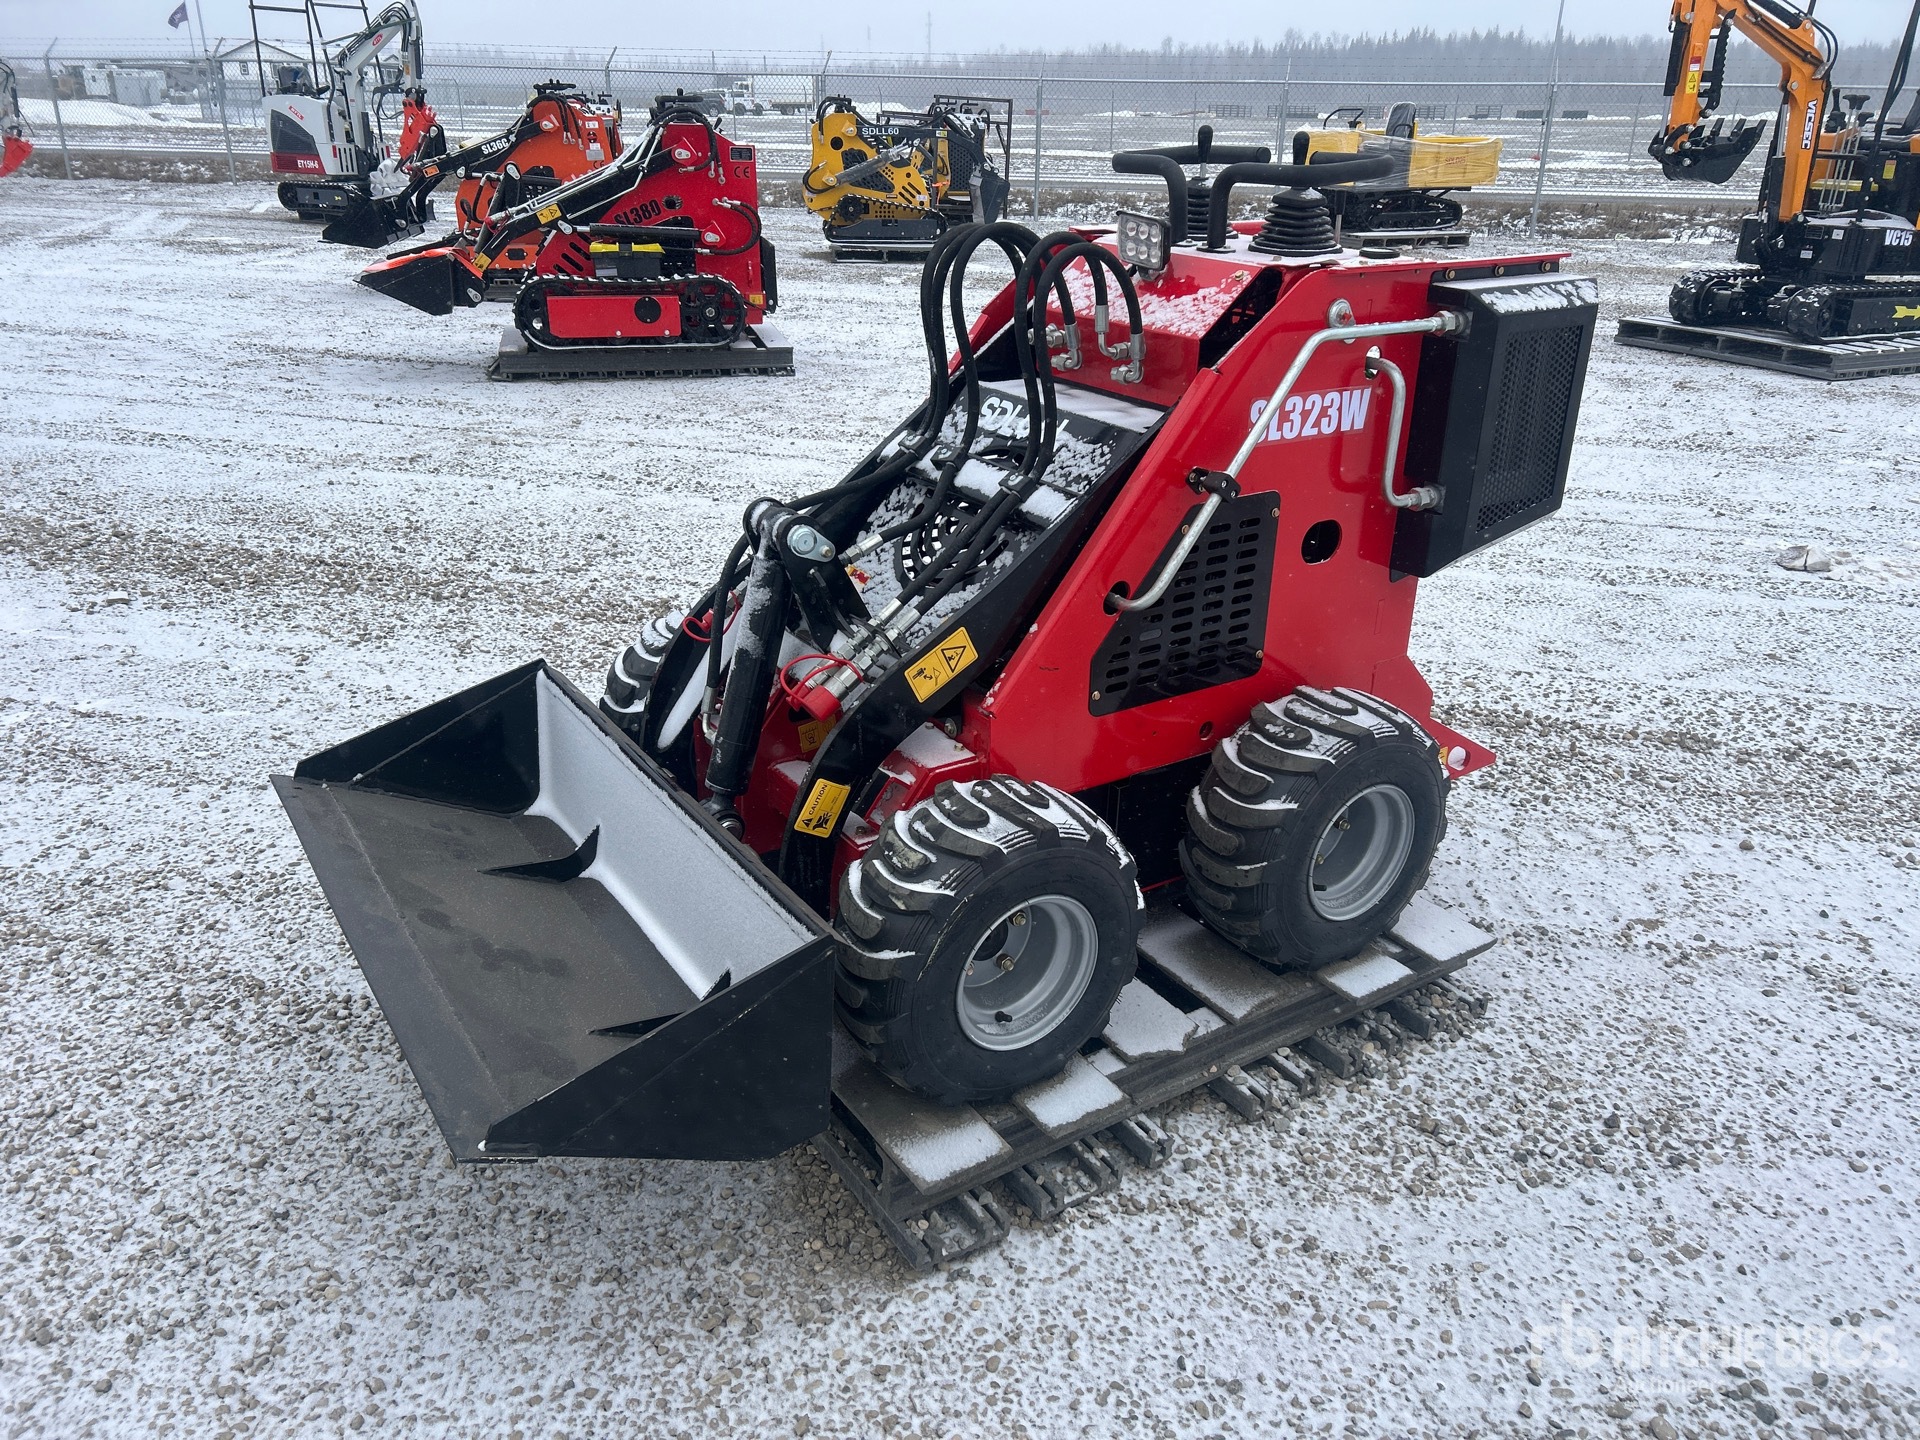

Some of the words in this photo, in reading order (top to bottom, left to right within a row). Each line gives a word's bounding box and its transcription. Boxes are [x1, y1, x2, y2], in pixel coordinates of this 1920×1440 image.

[862, 127, 899, 135] SDLL60
[1801, 99, 1818, 149] VICSEC
[1884, 229, 1913, 247] VC15
[1249, 387, 1371, 443] SL323W
[808, 783, 828, 816] CAUTION
